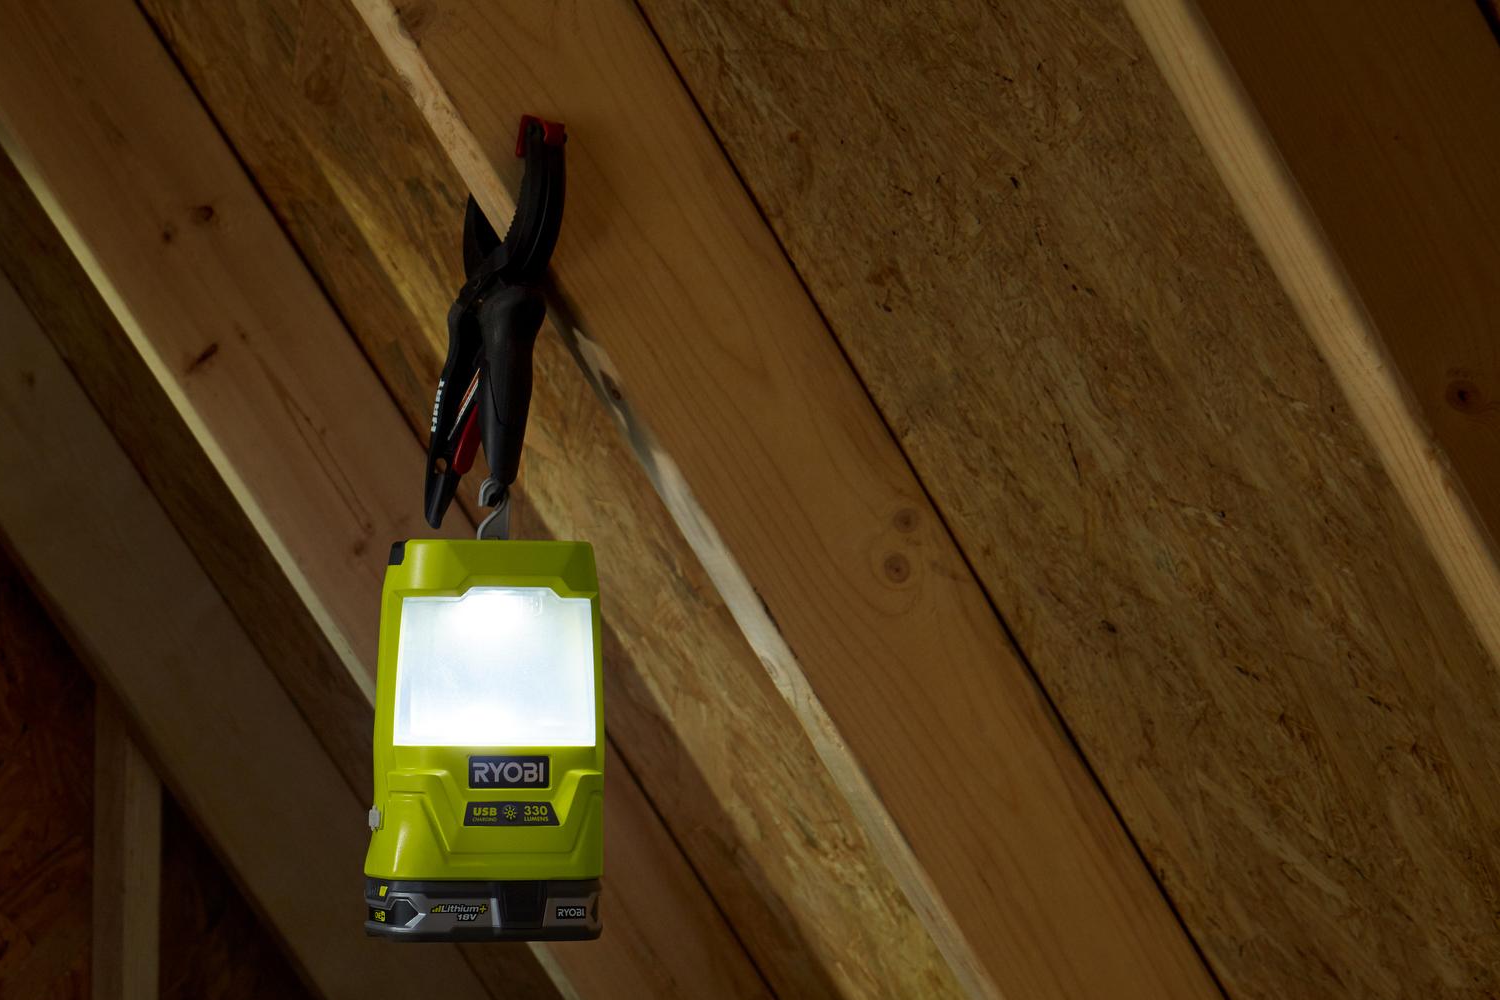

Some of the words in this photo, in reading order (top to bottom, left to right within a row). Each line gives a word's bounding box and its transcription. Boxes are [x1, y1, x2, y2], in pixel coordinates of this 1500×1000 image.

[472, 761, 545, 783] RYOBI
[472, 807, 498, 817] USB
[523, 805, 549, 816] 330
[457, 913, 478, 921] 18V
[558, 908, 585, 917] RYOBI
